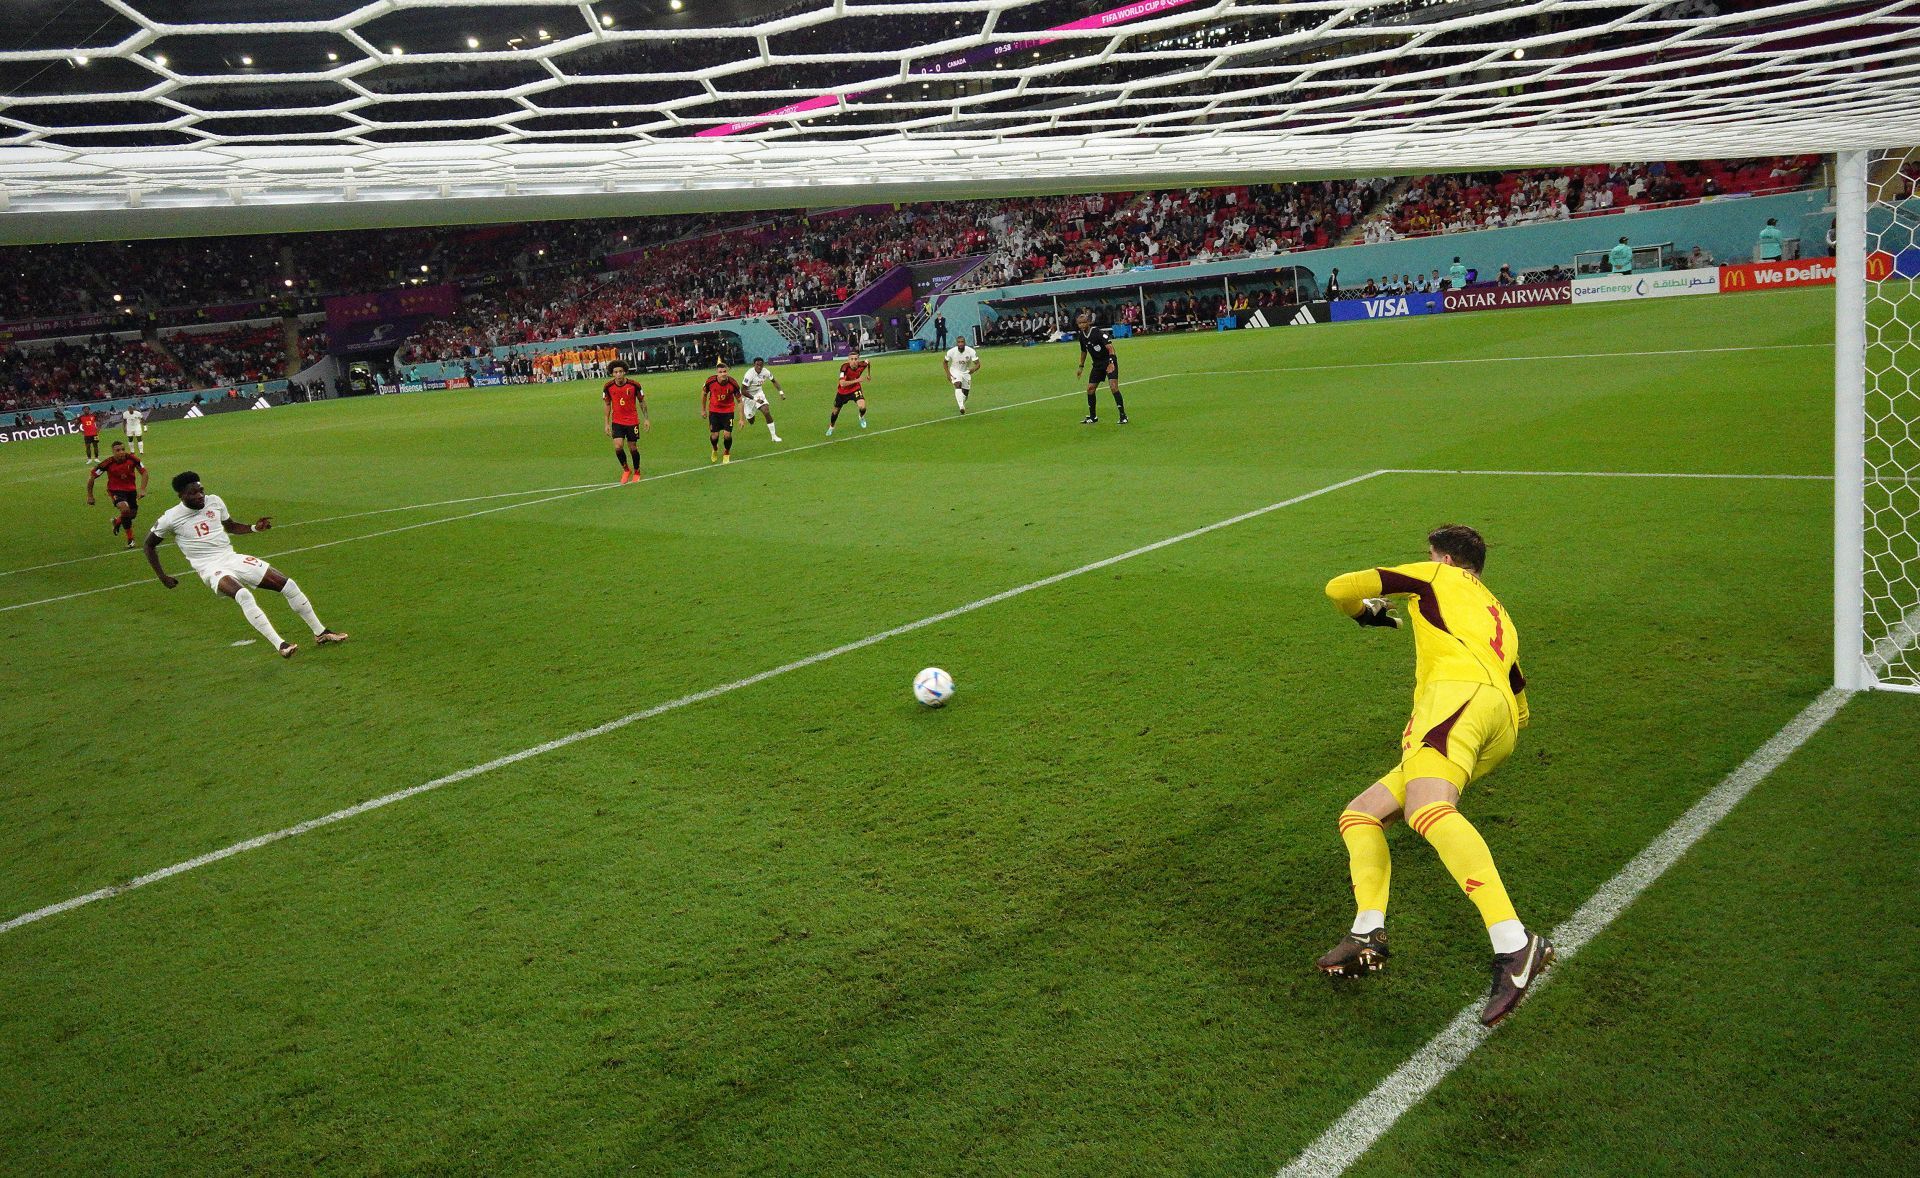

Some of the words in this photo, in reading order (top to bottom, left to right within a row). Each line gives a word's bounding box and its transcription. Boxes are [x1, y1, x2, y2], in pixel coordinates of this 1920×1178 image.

[1101, 12, 1118, 24] FIFA
[1119, 5, 1145, 19] WORLD
[1145, 0, 1160, 11] CUP
[994, 43, 1012, 55] 09:58
[935, 64, 941, 72] 0
[947, 58, 967, 69] CANADA
[1753, 270, 1783, 285] We
[1574, 284, 1633, 296] QatarEnergy
[1443, 292, 1497, 310] QATAR
[1500, 286, 1571, 305] AIRWAYS
[1361, 297, 1410, 318] VISA
[399, 383, 423, 394] Hisense
[619, 398, 625, 406] 6
[12, 422, 66, 442] match
[633, 425, 639, 434] 6
[193, 522, 210, 538] 19
[242, 555, 259, 567] 19
[1486, 604, 1505, 662] 1
